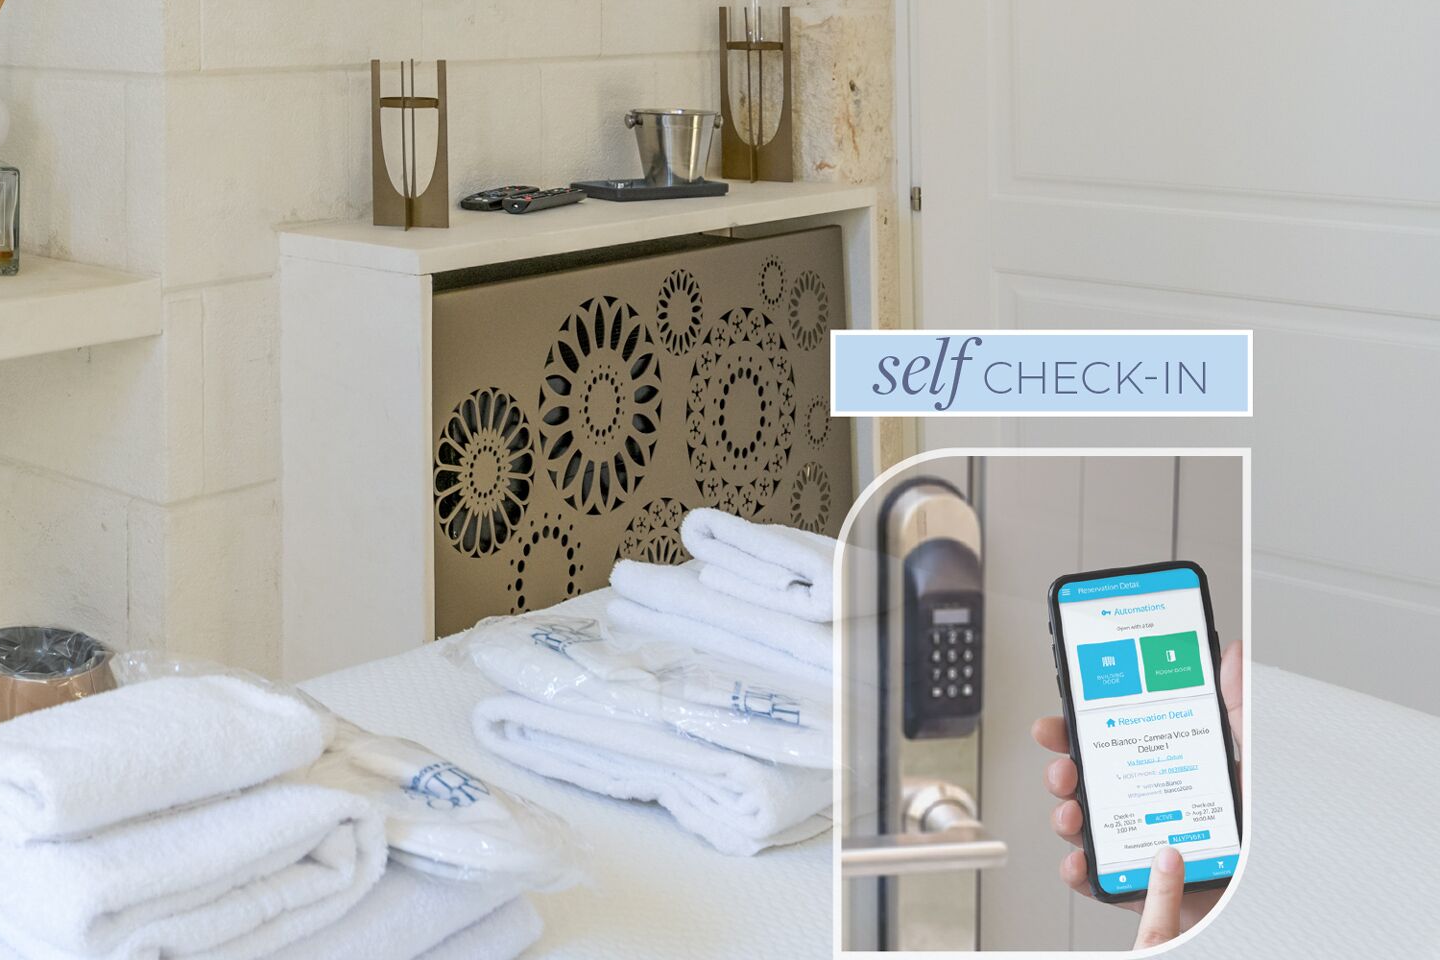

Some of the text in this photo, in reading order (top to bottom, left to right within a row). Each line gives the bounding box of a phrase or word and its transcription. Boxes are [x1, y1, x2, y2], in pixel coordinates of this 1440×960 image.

[1078, 583, 1118, 594] Reservation
[1114, 602, 1166, 616] Automations
[1118, 709, 1193, 725] Reservation Detail
[1111, 737, 1137, 746] Bianco
[1144, 732, 1172, 743] Camera
[1173, 730, 1189, 739] Vico
[1138, 744, 1165, 753] Deluxe
